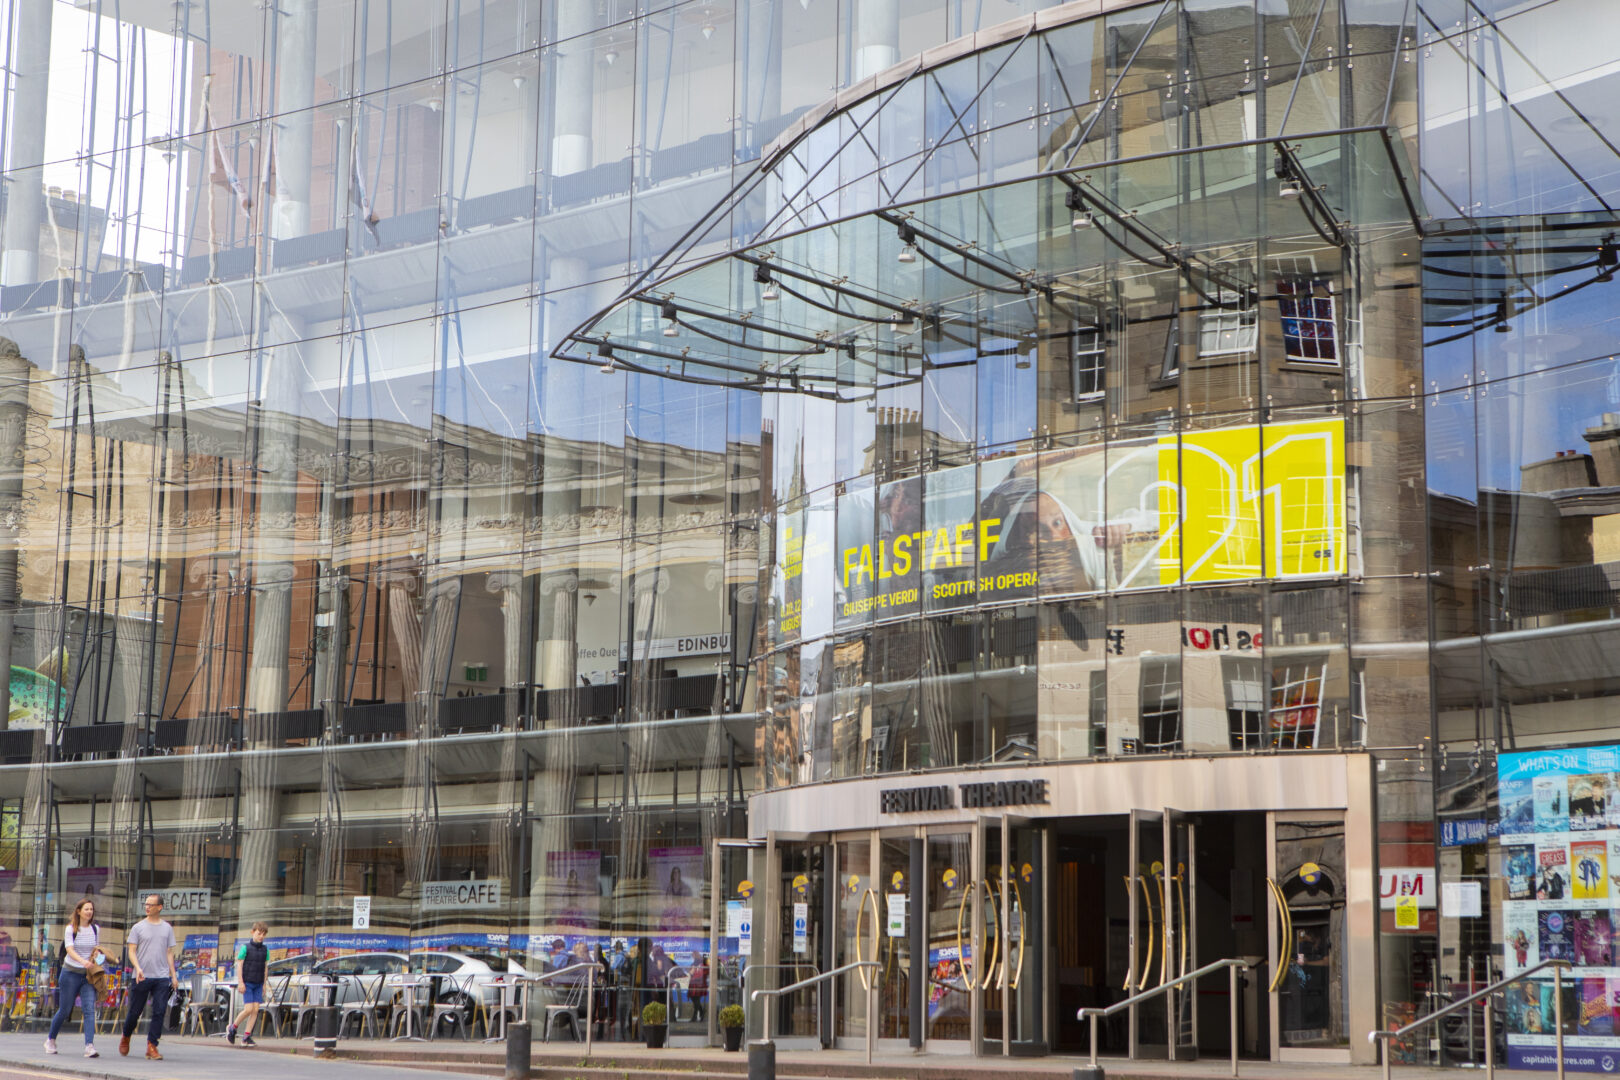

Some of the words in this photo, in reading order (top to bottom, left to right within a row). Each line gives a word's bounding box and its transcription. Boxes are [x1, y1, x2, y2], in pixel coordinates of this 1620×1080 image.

[843, 518, 1001, 588] FALSTAFF
[933, 577, 993, 599] SCOTTISH
[996, 571, 1041, 590] OPERA
[843, 594, 887, 617] GIUSEPPE
[889, 588, 918, 608] VERDI
[577, 648, 597, 659] ffee
[1518, 756, 1560, 772] WHAT'S
[1563, 754, 1579, 769] ON
[880, 785, 957, 814] FESTIVAL
[959, 779, 1050, 809] THEATRE
[1541, 851, 1565, 865] GREASE
[425, 885, 457, 895] FESTIVAL
[426, 895, 457, 905] THEATRE
[1522, 1056, 1595, 1066] capitalthetres.com
